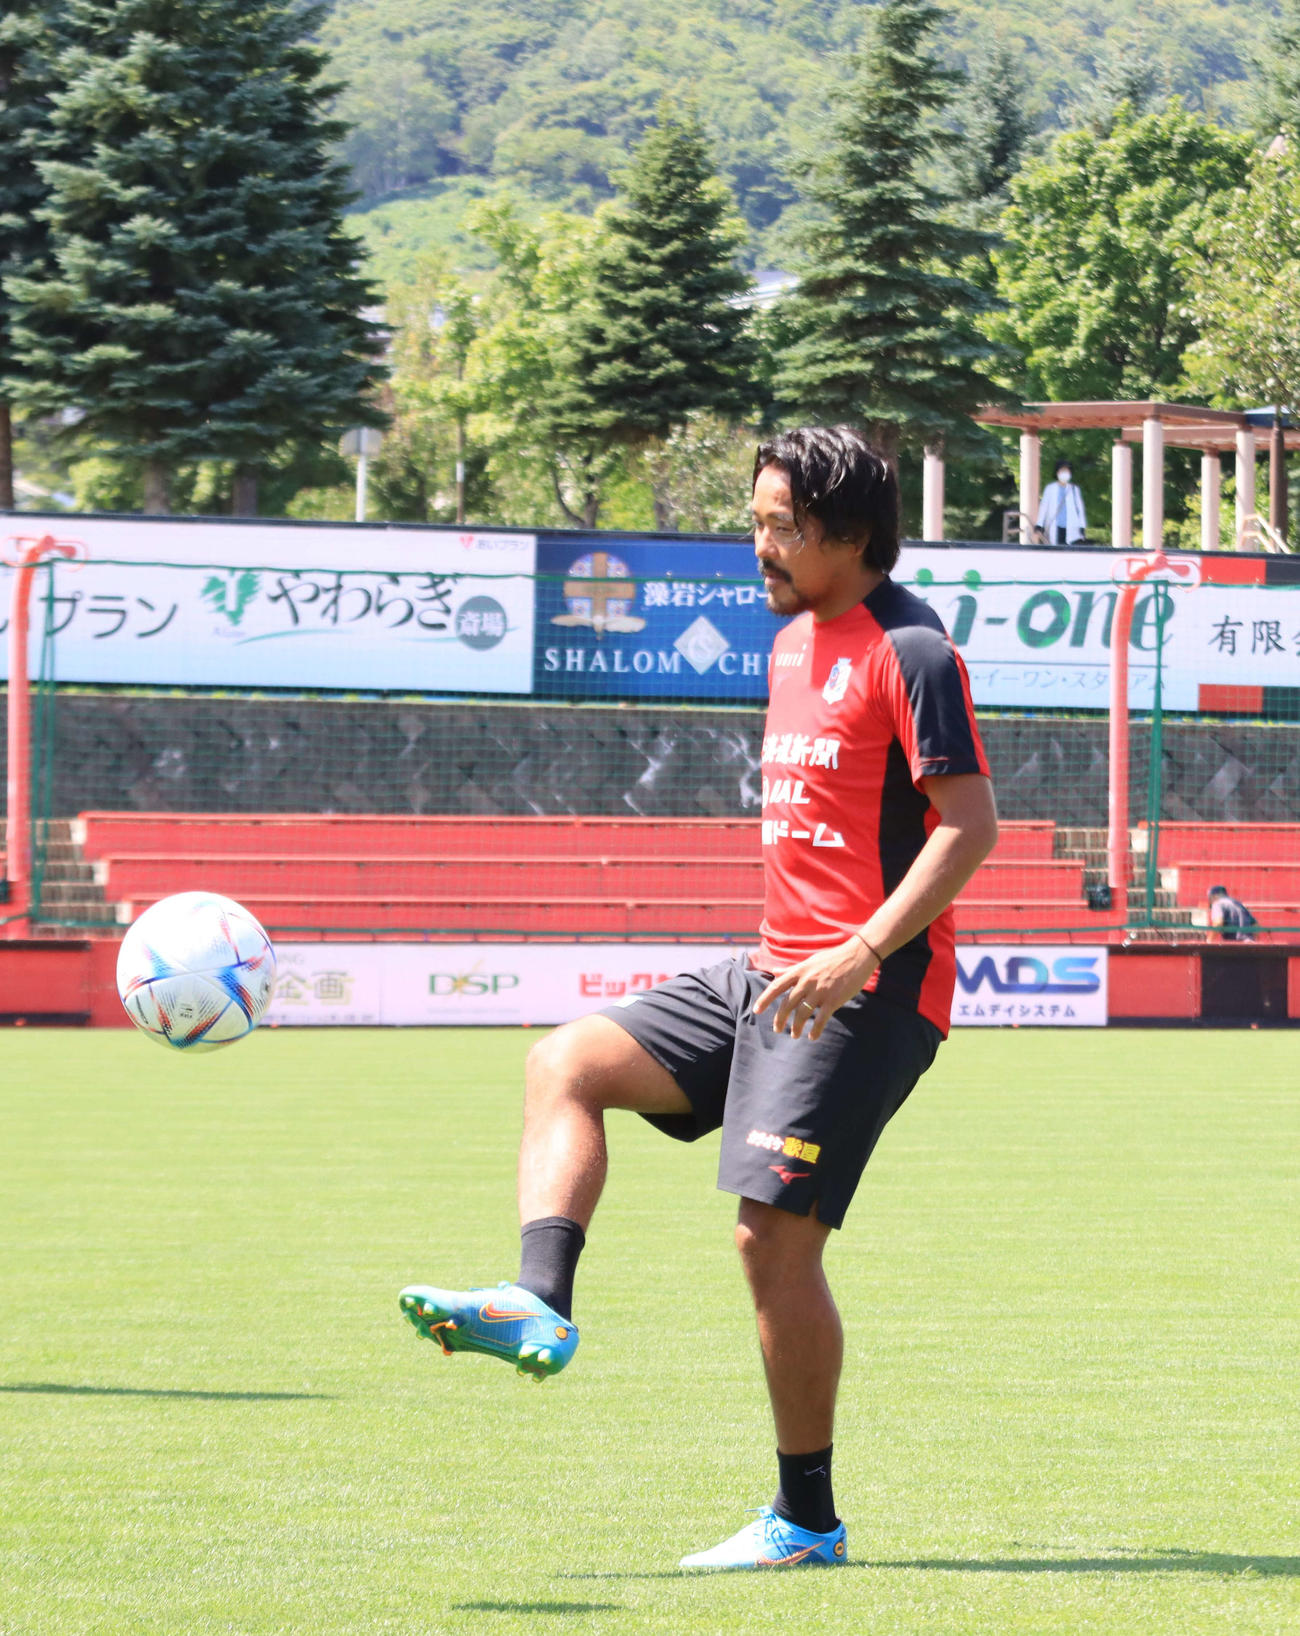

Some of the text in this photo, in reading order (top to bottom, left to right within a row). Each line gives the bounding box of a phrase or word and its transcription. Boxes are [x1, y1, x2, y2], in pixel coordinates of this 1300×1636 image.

[0, 590, 178, 639] プラン
[267, 573, 458, 631] やわらぎ
[1208, 614, 1300, 656] 有限
[543, 649, 775, 675] SHALOM CH
[428, 973, 520, 996] DSP
